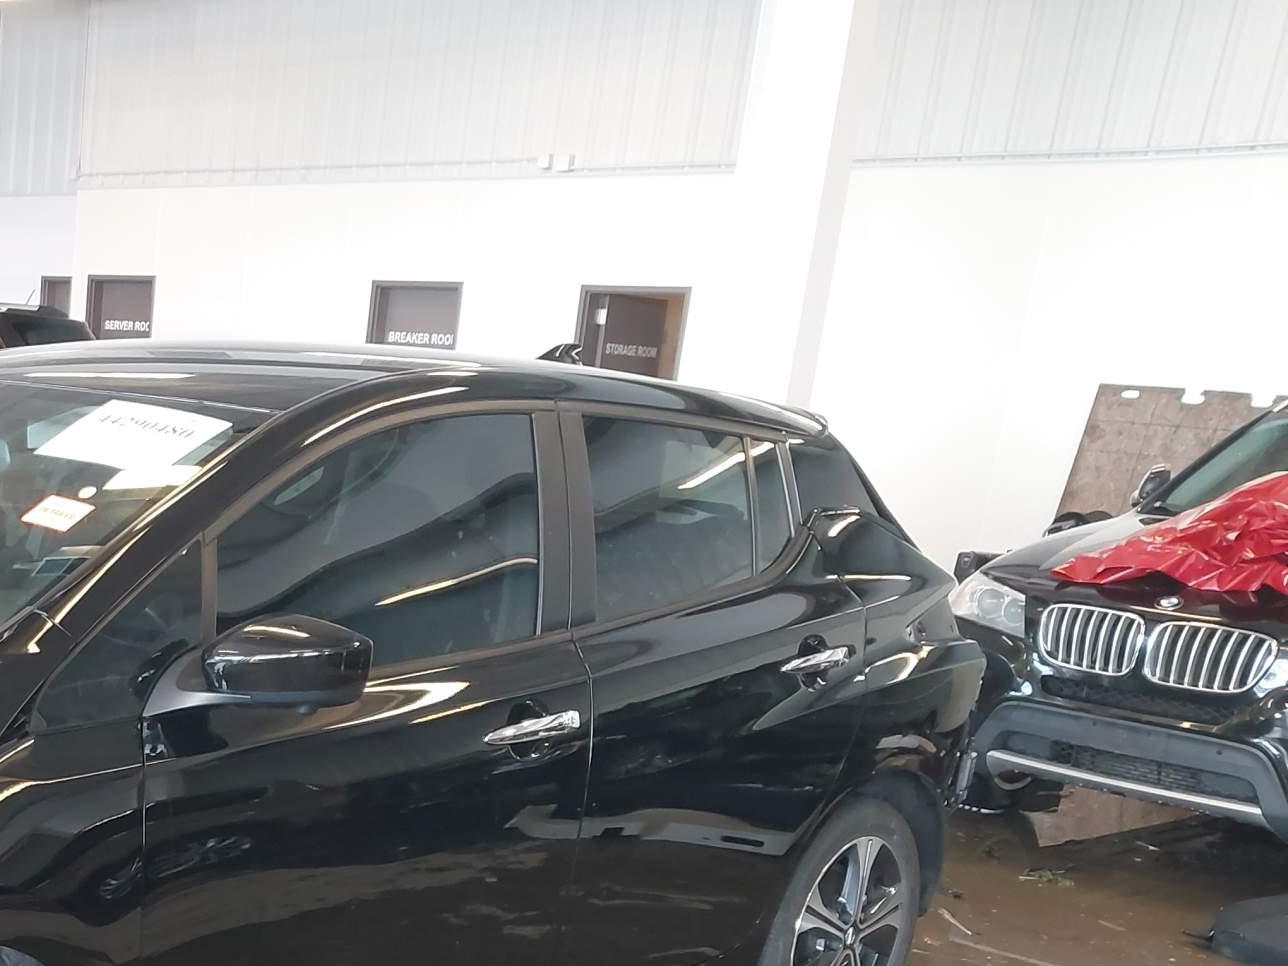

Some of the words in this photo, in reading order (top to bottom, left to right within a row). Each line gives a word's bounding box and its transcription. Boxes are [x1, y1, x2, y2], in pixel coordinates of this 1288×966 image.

[104, 319, 133, 331] SERVER
[387, 331, 429, 345] BREAKER
[605, 342, 636, 356] STORAGE
